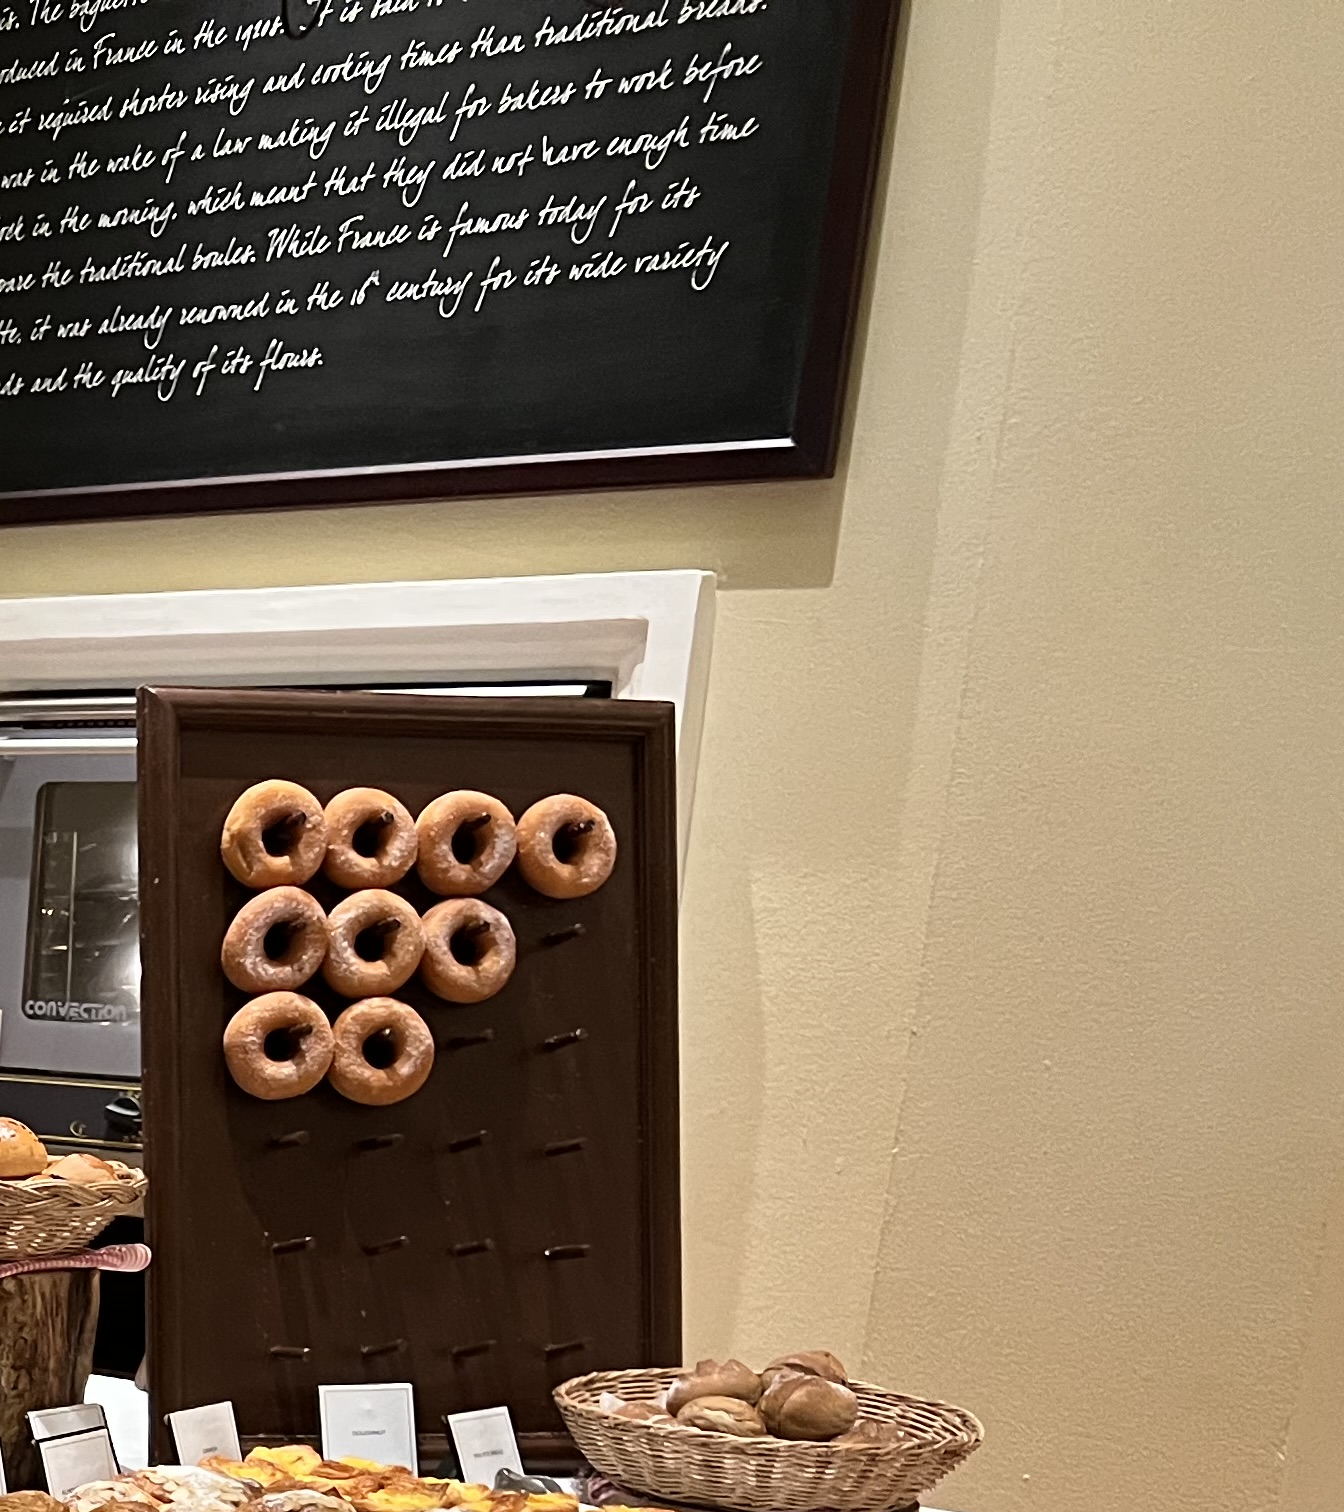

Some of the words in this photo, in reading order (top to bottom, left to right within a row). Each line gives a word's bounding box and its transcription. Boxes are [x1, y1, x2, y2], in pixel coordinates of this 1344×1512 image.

[29, 0, 65, 26] The
[64, 48, 86, 73] in
[93, 32, 159, 70] France
[163, 29, 186, 55] in
[193, 18, 229, 50] the
[339, 0, 364, 23] is
[0, 167, 36, 189] was
[40, 159, 62, 184] in
[67, 150, 101, 180] the
[106, 143, 157, 173] wake
[161, 130, 188, 184] of
[190, 143, 206, 161] a
[212, 127, 253, 158] law
[257, 118, 337, 160] making
[343, 105, 370, 137] it
[375, 91, 450, 147] illegal
[449, 83, 493, 142] for
[497, 79, 577, 114] bakers
[584, 67, 614, 100] to
[617, 58, 675, 94] work
[682, 42, 763, 104] before
[8, 107, 32, 134] it
[37, 95, 113, 142] required
[118, 82, 189, 119] shorter
[194, 74, 255, 116] rising
[262, 62, 306, 94] and
[310, 51, 392, 95] cooking
[399, 39, 464, 71] times
[469, 25, 526, 59] than
[534, 0, 669, 48] traditional
[31, 213, 53, 238] in
[59, 205, 93, 234] the
[187, 181, 246, 216] which
[249, 170, 318, 207] meant
[323, 161, 377, 197] that
[382, 155, 436, 208] they
[442, 149, 486, 180] did
[491, 144, 535, 177] not
[542, 135, 601, 166] have
[606, 115, 690, 171] enough
[698, 111, 760, 144] time
[41, 260, 74, 289] the
[79, 243, 188, 284] traditional
[190, 236, 257, 271] boules.
[265, 223, 332, 263] While
[337, 214, 412, 253] France
[417, 214, 443, 241] is
[442, 201, 530, 258] famous
[537, 194, 608, 245] today
[608, 179, 654, 238] for
[661, 176, 702, 210] its
[30, 314, 52, 341] it
[56, 318, 93, 339] was
[97, 304, 173, 350] already
[179, 291, 270, 326] renowned
[275, 289, 300, 315] in
[306, 281, 344, 311] the
[385, 268, 474, 319] century
[474, 255, 518, 313] for
[523, 255, 562, 286] its
[568, 250, 628, 281] wide
[634, 235, 730, 291] variety
[30, 367, 68, 393] and
[73, 361, 106, 389] the
[110, 353, 187, 402] quality
[192, 344, 219, 396] of
[220, 346, 254, 375] its
[253, 338, 324, 392] flours.
